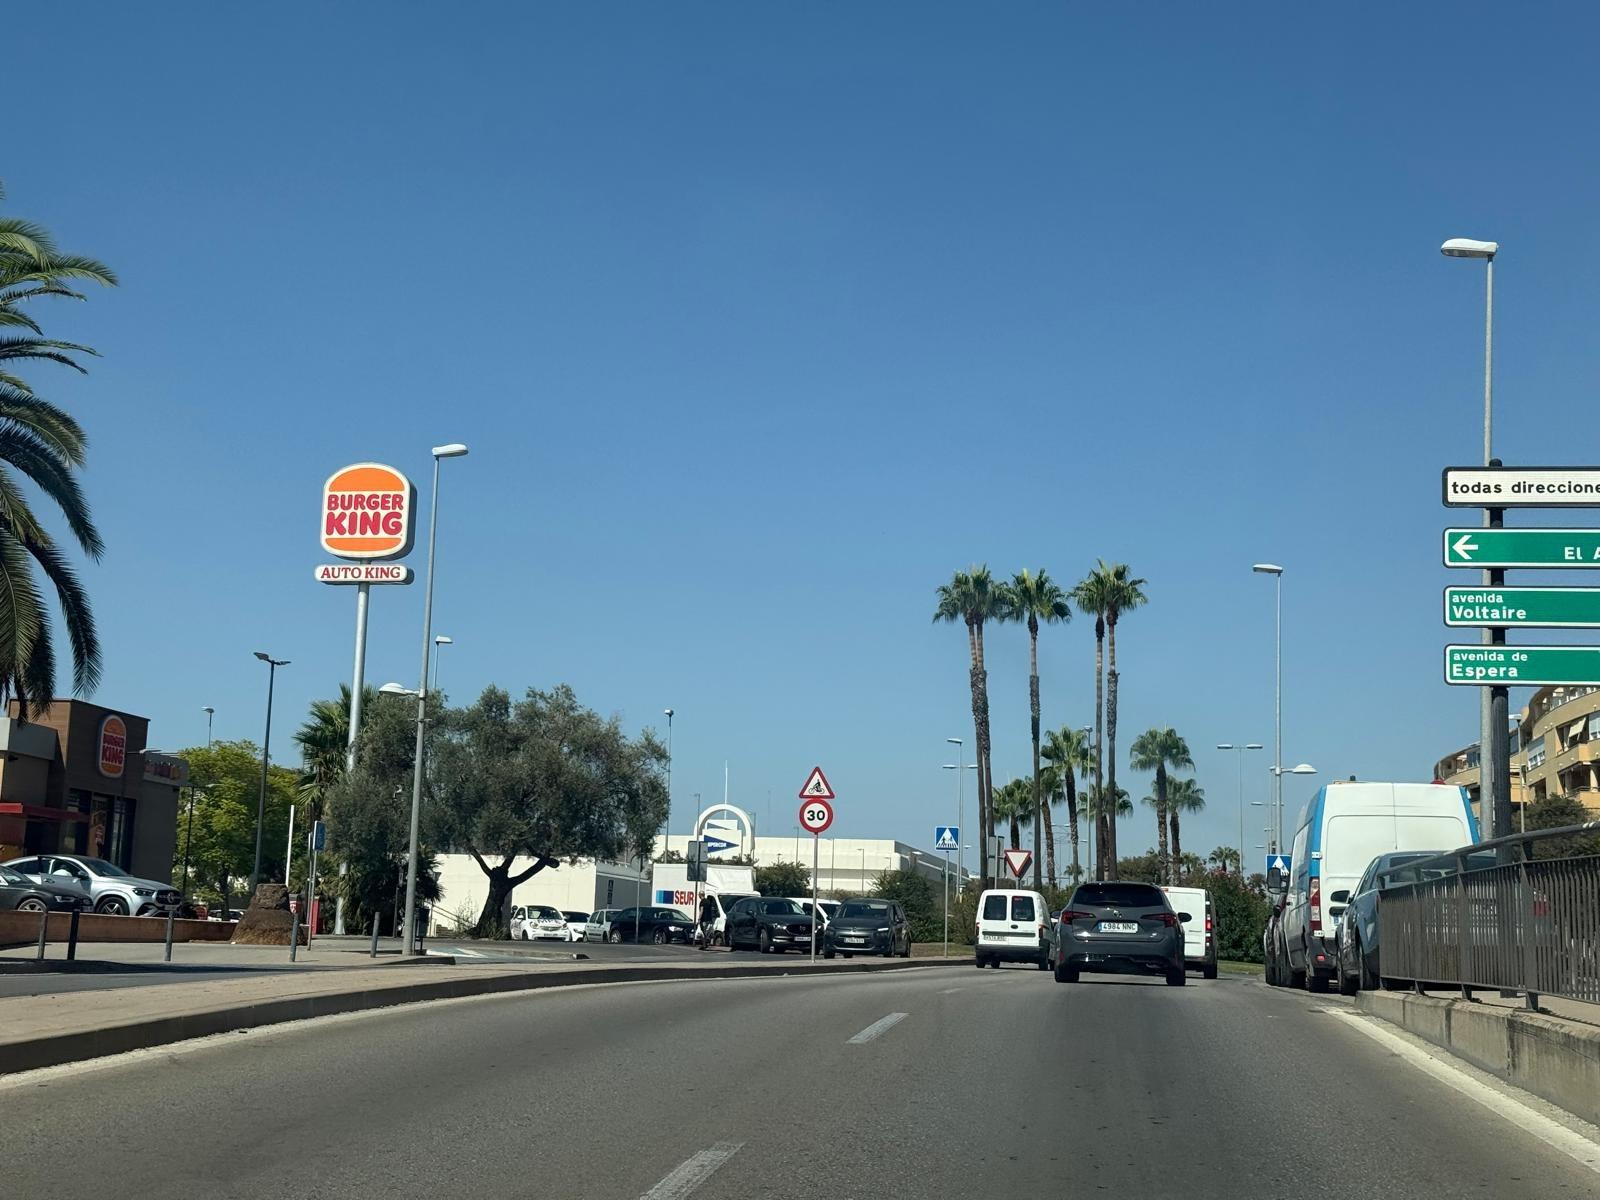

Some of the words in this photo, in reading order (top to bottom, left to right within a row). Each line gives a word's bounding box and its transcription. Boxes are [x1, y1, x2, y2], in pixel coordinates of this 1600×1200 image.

[1452, 481, 1502, 494] todas
[327, 494, 404, 511] BURGER
[325, 511, 403, 536] KING
[1564, 546, 1583, 560] El
[320, 567, 362, 579] AUTO
[364, 567, 401, 579] KING
[1452, 592, 1503, 603] avenida
[1452, 605, 1527, 619] Voltaire
[1453, 651, 1505, 661] avenida
[1511, 652, 1528, 661] de
[1452, 663, 1518, 680] Espera
[102, 745, 124, 765] KING
[807, 810, 826, 821] 30
[674, 890, 695, 906] SEUR
[1102, 922, 1121, 930] 4984
[1122, 923, 1136, 931] NNC
